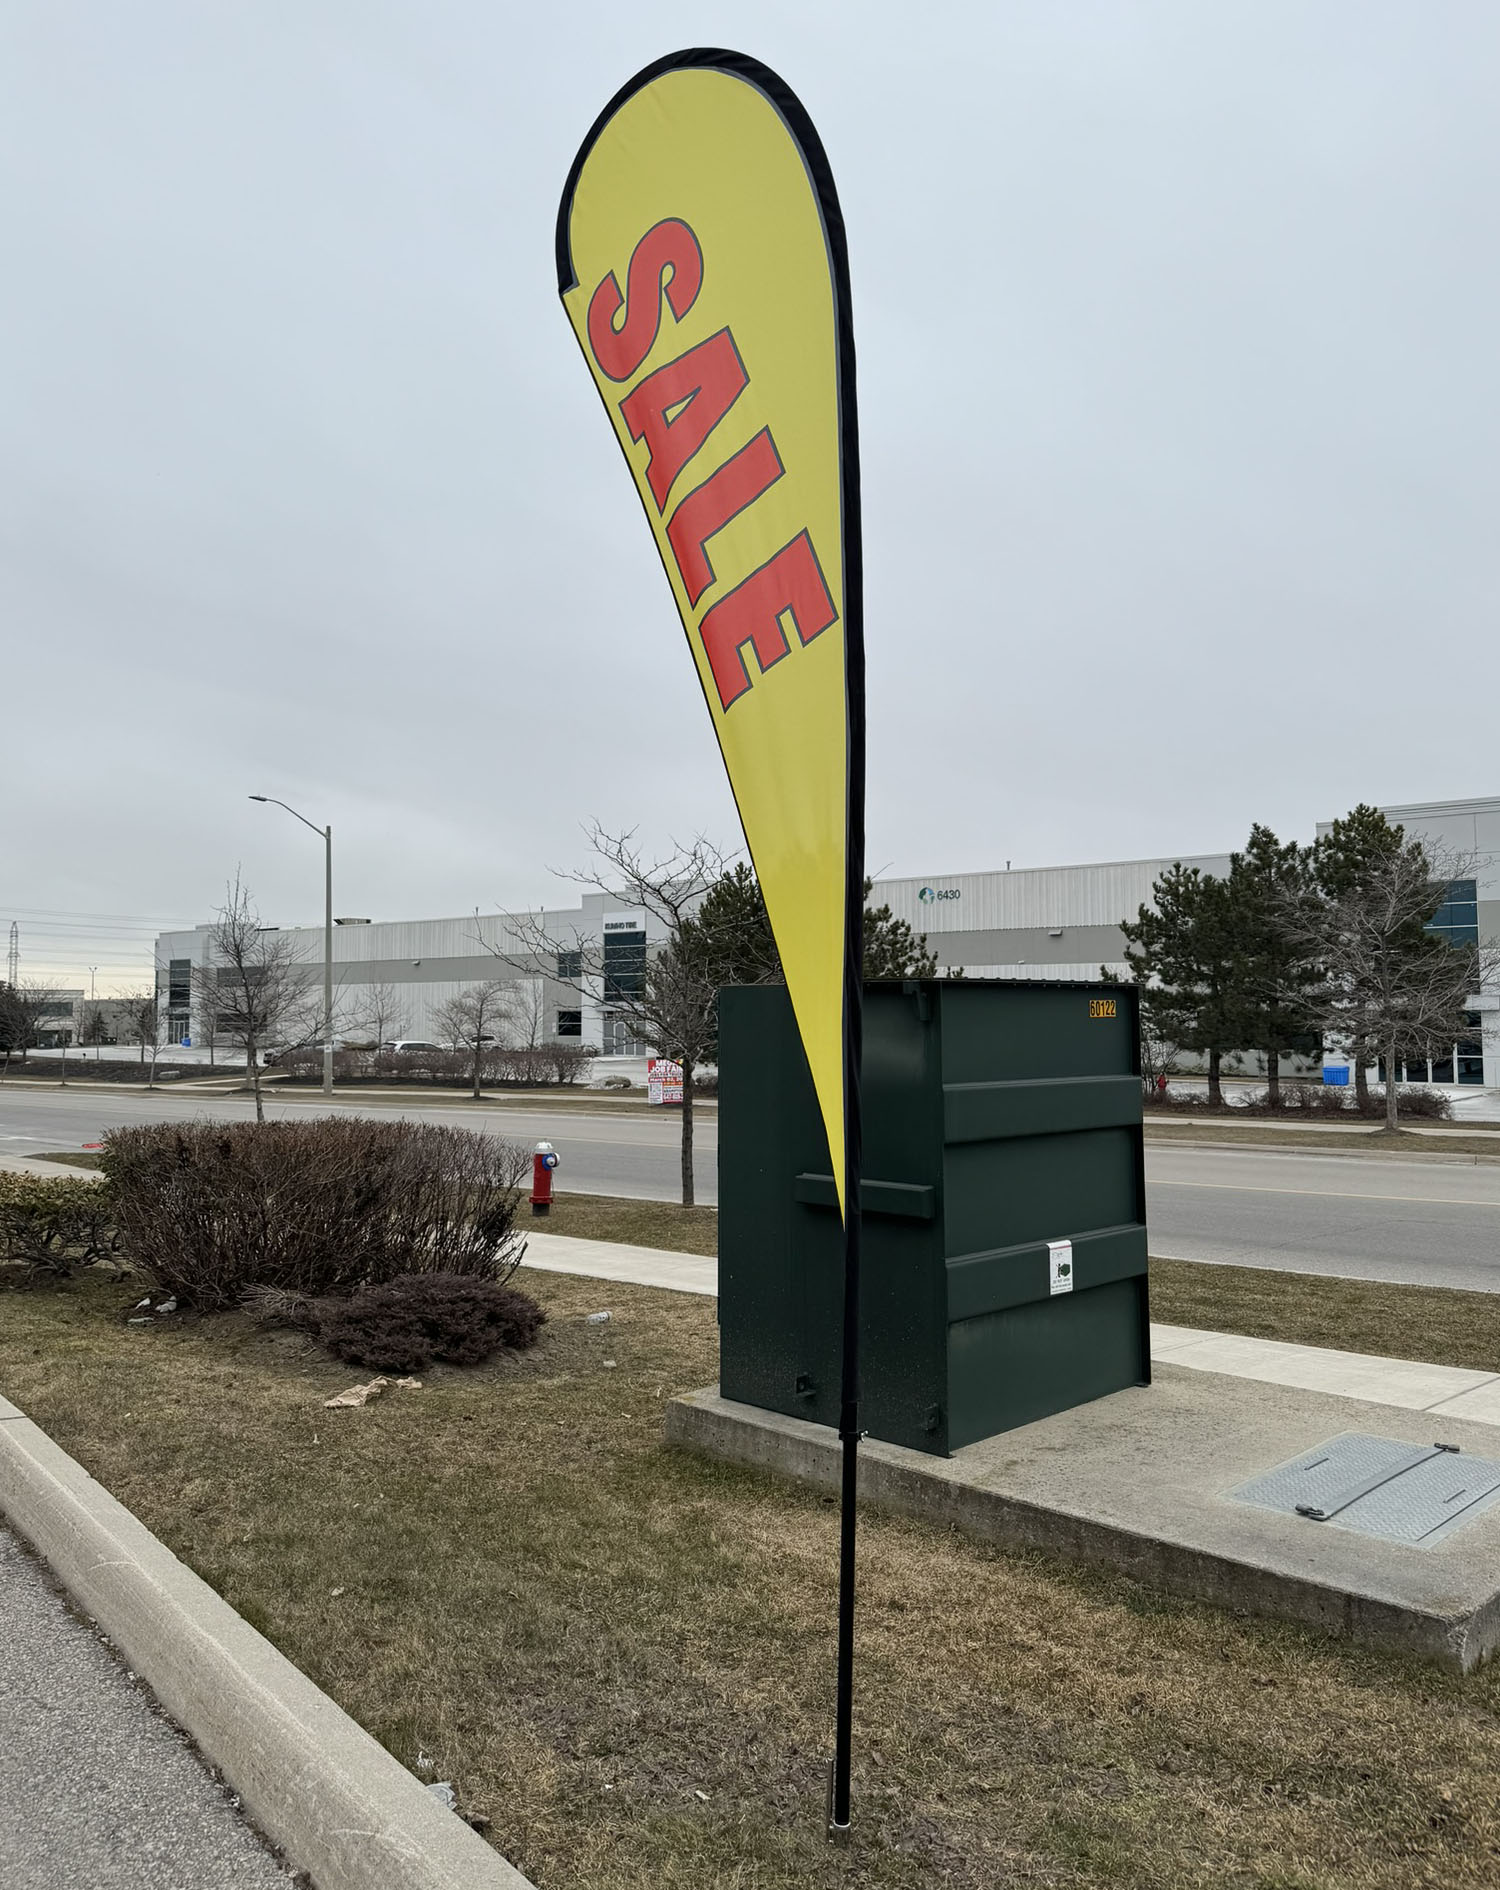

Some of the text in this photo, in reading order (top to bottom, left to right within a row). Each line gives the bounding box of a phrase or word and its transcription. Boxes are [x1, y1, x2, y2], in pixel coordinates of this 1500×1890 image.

[587, 216, 840, 714] SALE
[937, 889, 961, 901] 6430
[1090, 1000, 1115, 1017] 60122
